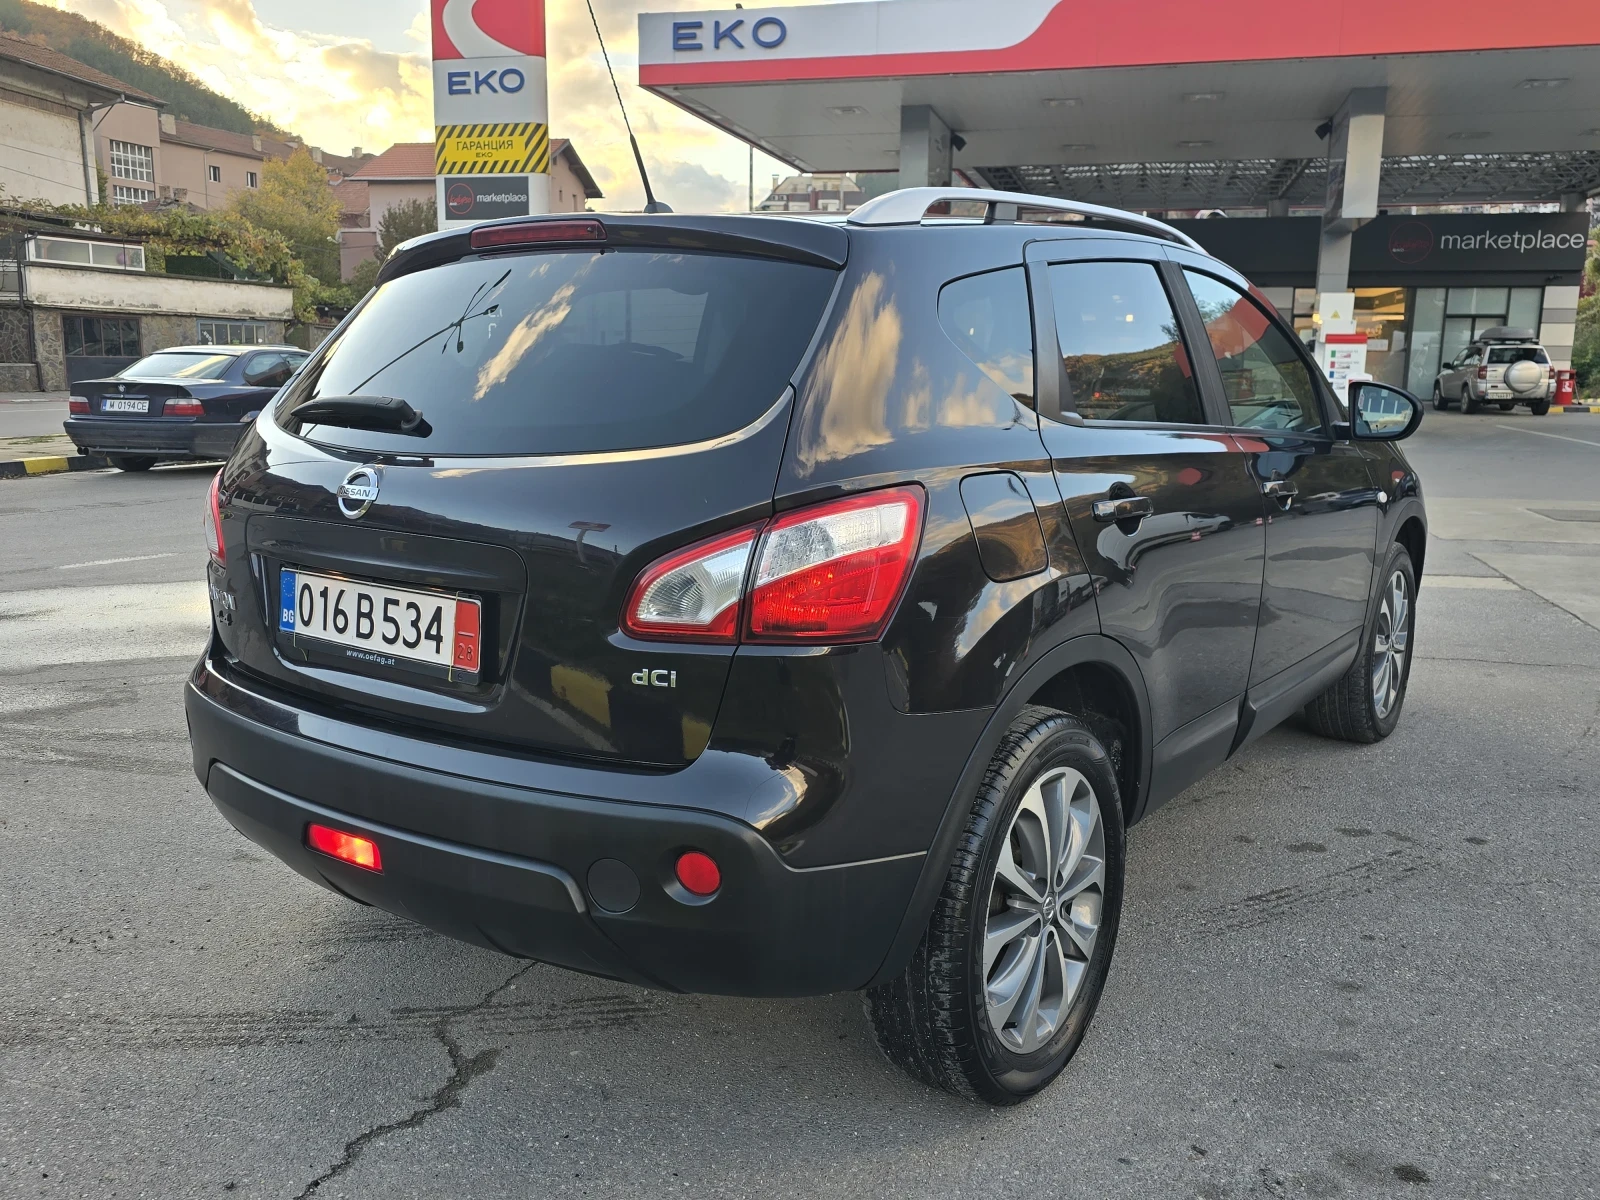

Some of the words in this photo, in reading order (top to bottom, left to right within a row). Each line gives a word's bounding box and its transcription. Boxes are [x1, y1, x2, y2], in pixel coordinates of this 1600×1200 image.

[672, 17, 787, 50] EKO
[447, 68, 525, 95] EKO
[456, 140, 514, 151] ГАРАНЦИЯ
[476, 193, 527, 204] marketplace
[1440, 229, 1585, 253] marketplace
[282, 608, 295, 623] BG
[346, 650, 395, 666] www.oefag.at
